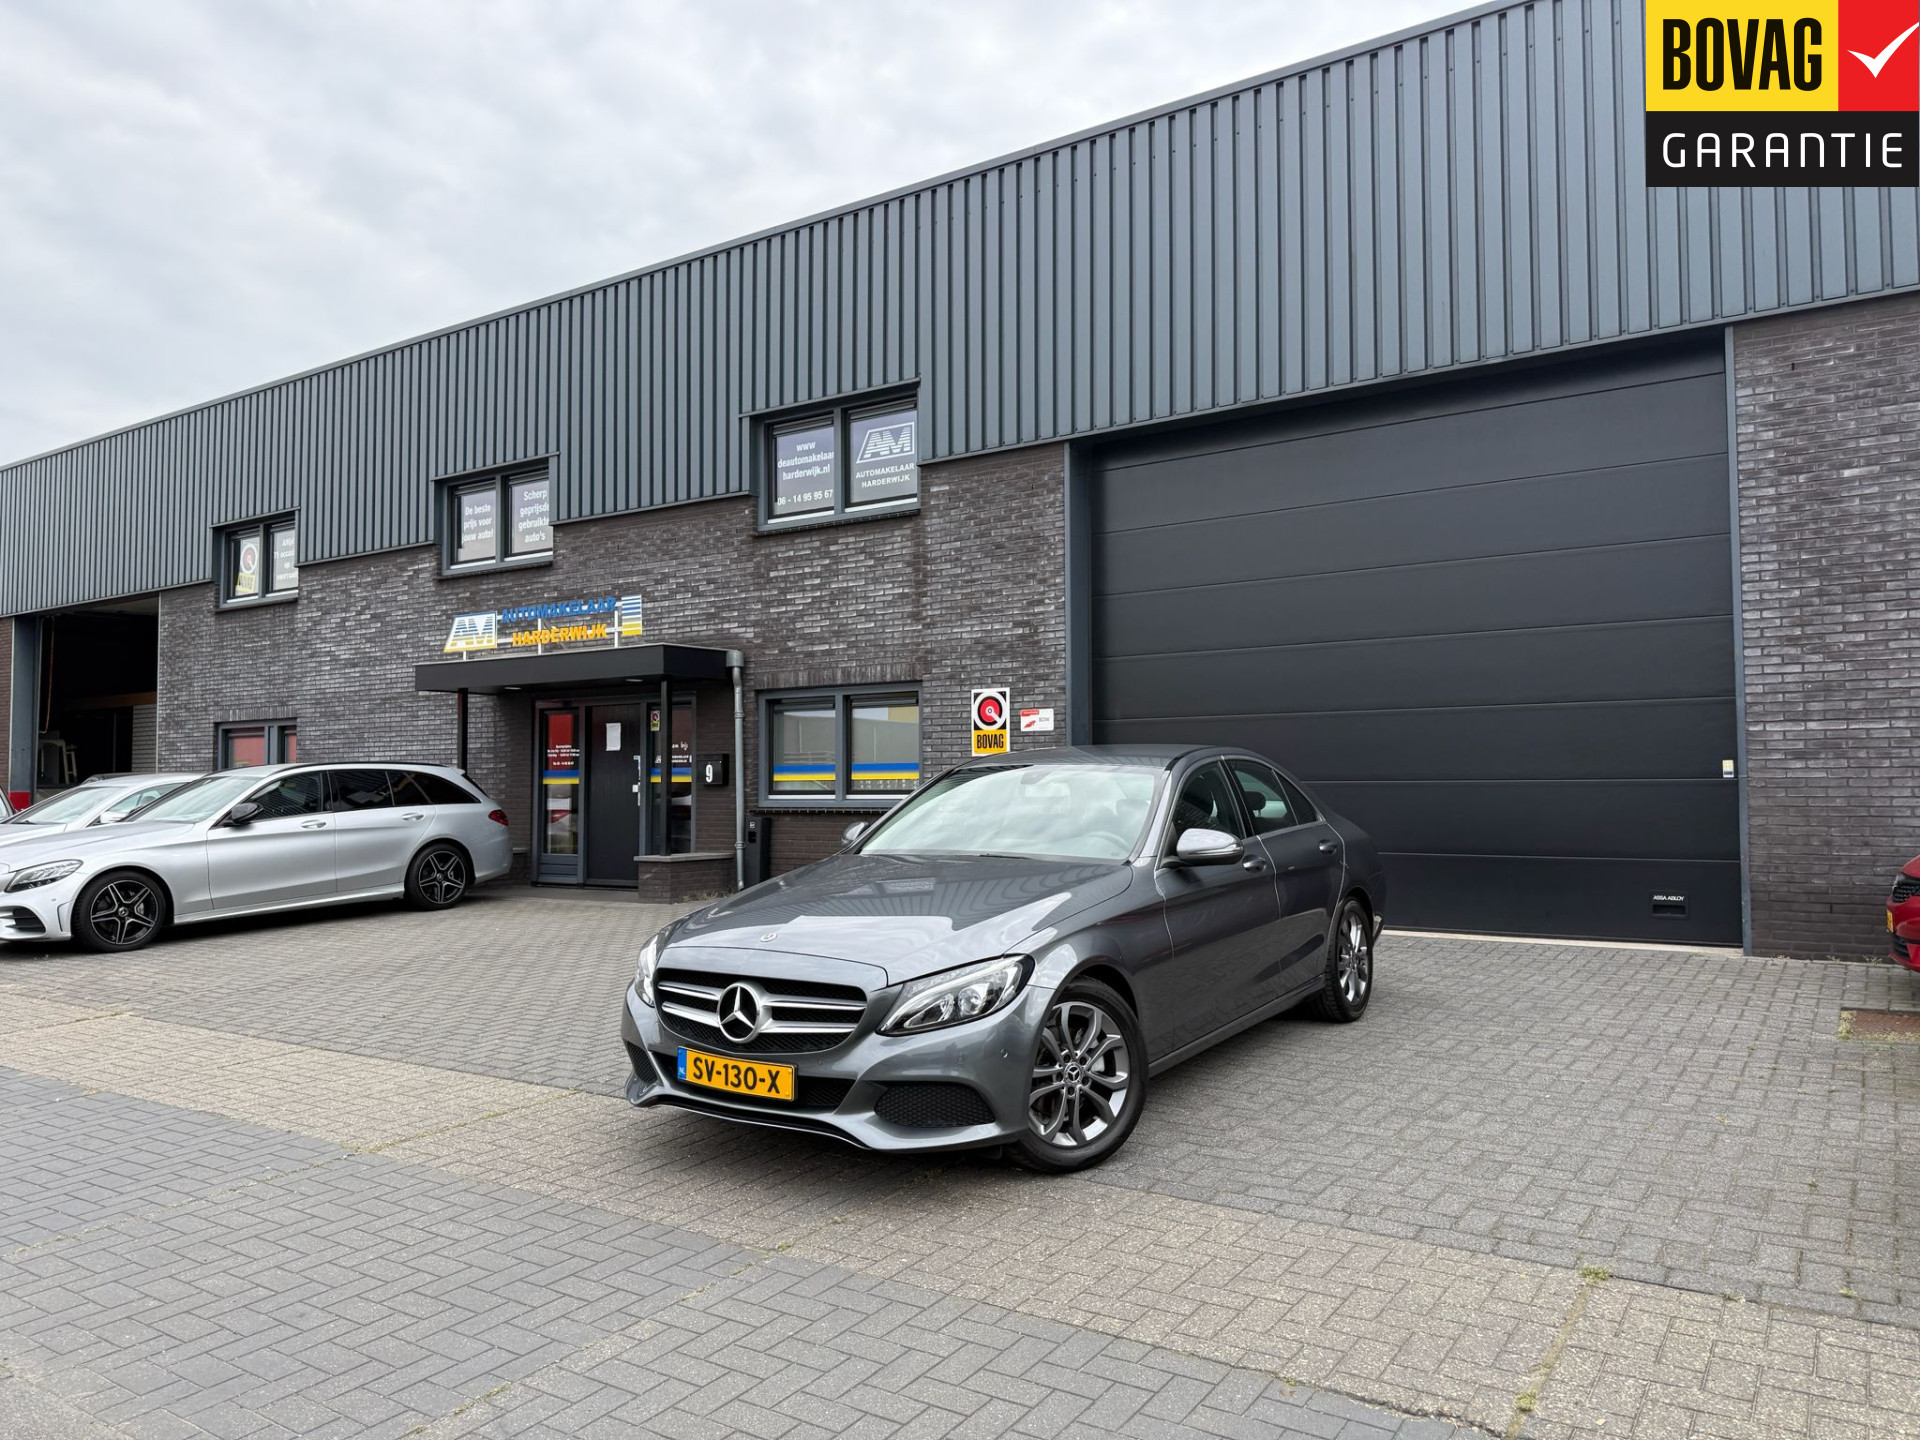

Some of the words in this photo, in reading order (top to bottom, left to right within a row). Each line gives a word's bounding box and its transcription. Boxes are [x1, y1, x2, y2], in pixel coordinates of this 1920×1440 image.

[796, 441, 816, 452] www
[782, 463, 830, 481] harderwijk.nl
[855, 462, 915, 479] AUTOMAKELAAR
[861, 474, 910, 488] HARDERWIJK
[523, 490, 548, 501] Scherp
[777, 496, 787, 506] 06
[793, 494, 802, 503] 14
[803, 491, 813, 502] 95
[813, 490, 823, 501] 95
[824, 489, 834, 499] 67
[465, 506, 473, 516] De
[474, 503, 491, 514] beste
[524, 531, 546, 543] auto's
[501, 597, 617, 623] AUTOMAKELAAR
[512, 623, 608, 646] HARDERWIJK
[976, 733, 1004, 749] BOVAG
[705, 764, 714, 783] 9
[693, 1056, 781, 1094] SV-130-X
